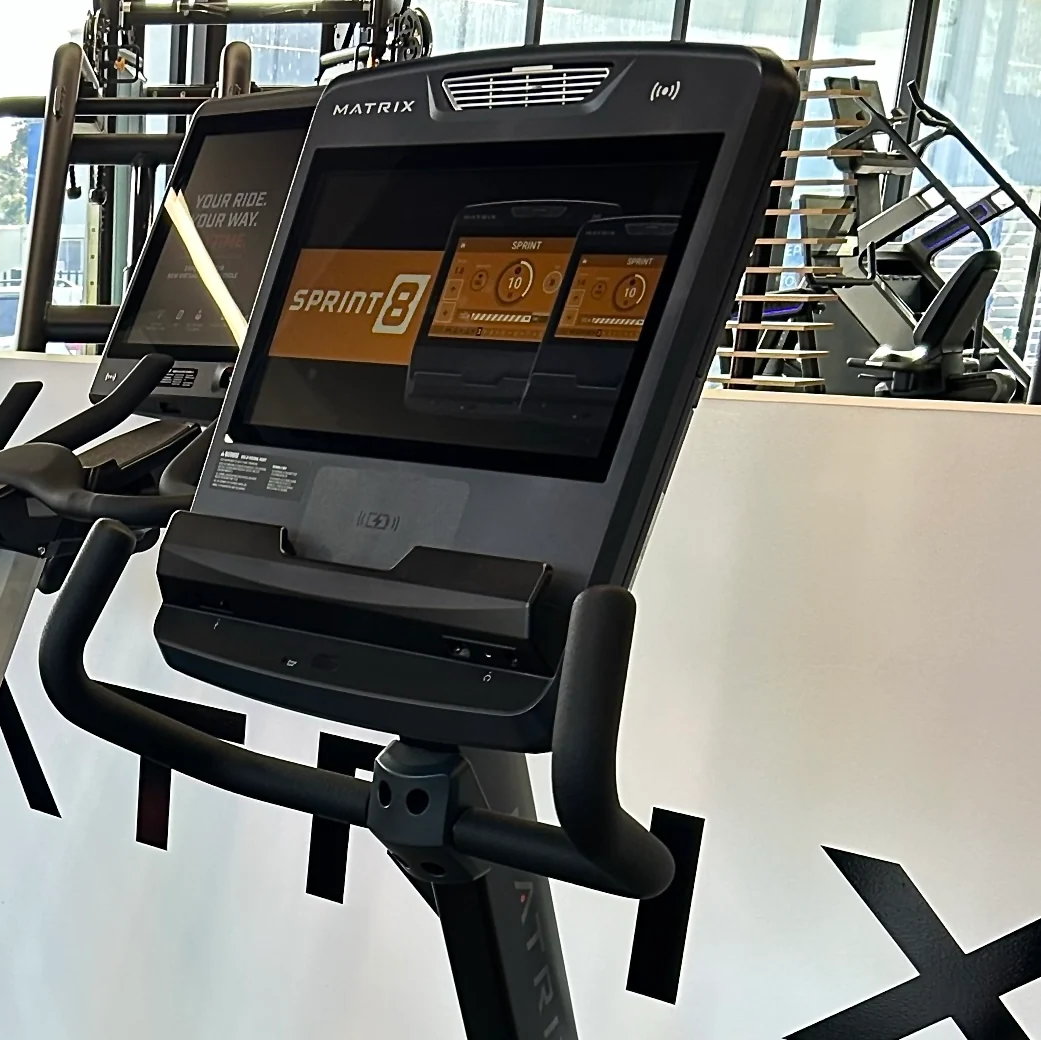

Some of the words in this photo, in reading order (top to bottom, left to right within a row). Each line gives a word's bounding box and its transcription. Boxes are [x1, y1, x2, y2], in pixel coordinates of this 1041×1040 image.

[332, 100, 415, 116] MATRIX
[196, 194, 227, 208] YOUR
[232, 192, 267, 208] RIDE.
[227, 211, 259, 227] WAY.
[511, 241, 542, 250] SPRINT
[627, 257, 654, 266] SPRINT
[508, 277, 523, 290] 10
[624, 288, 637, 299] 10
